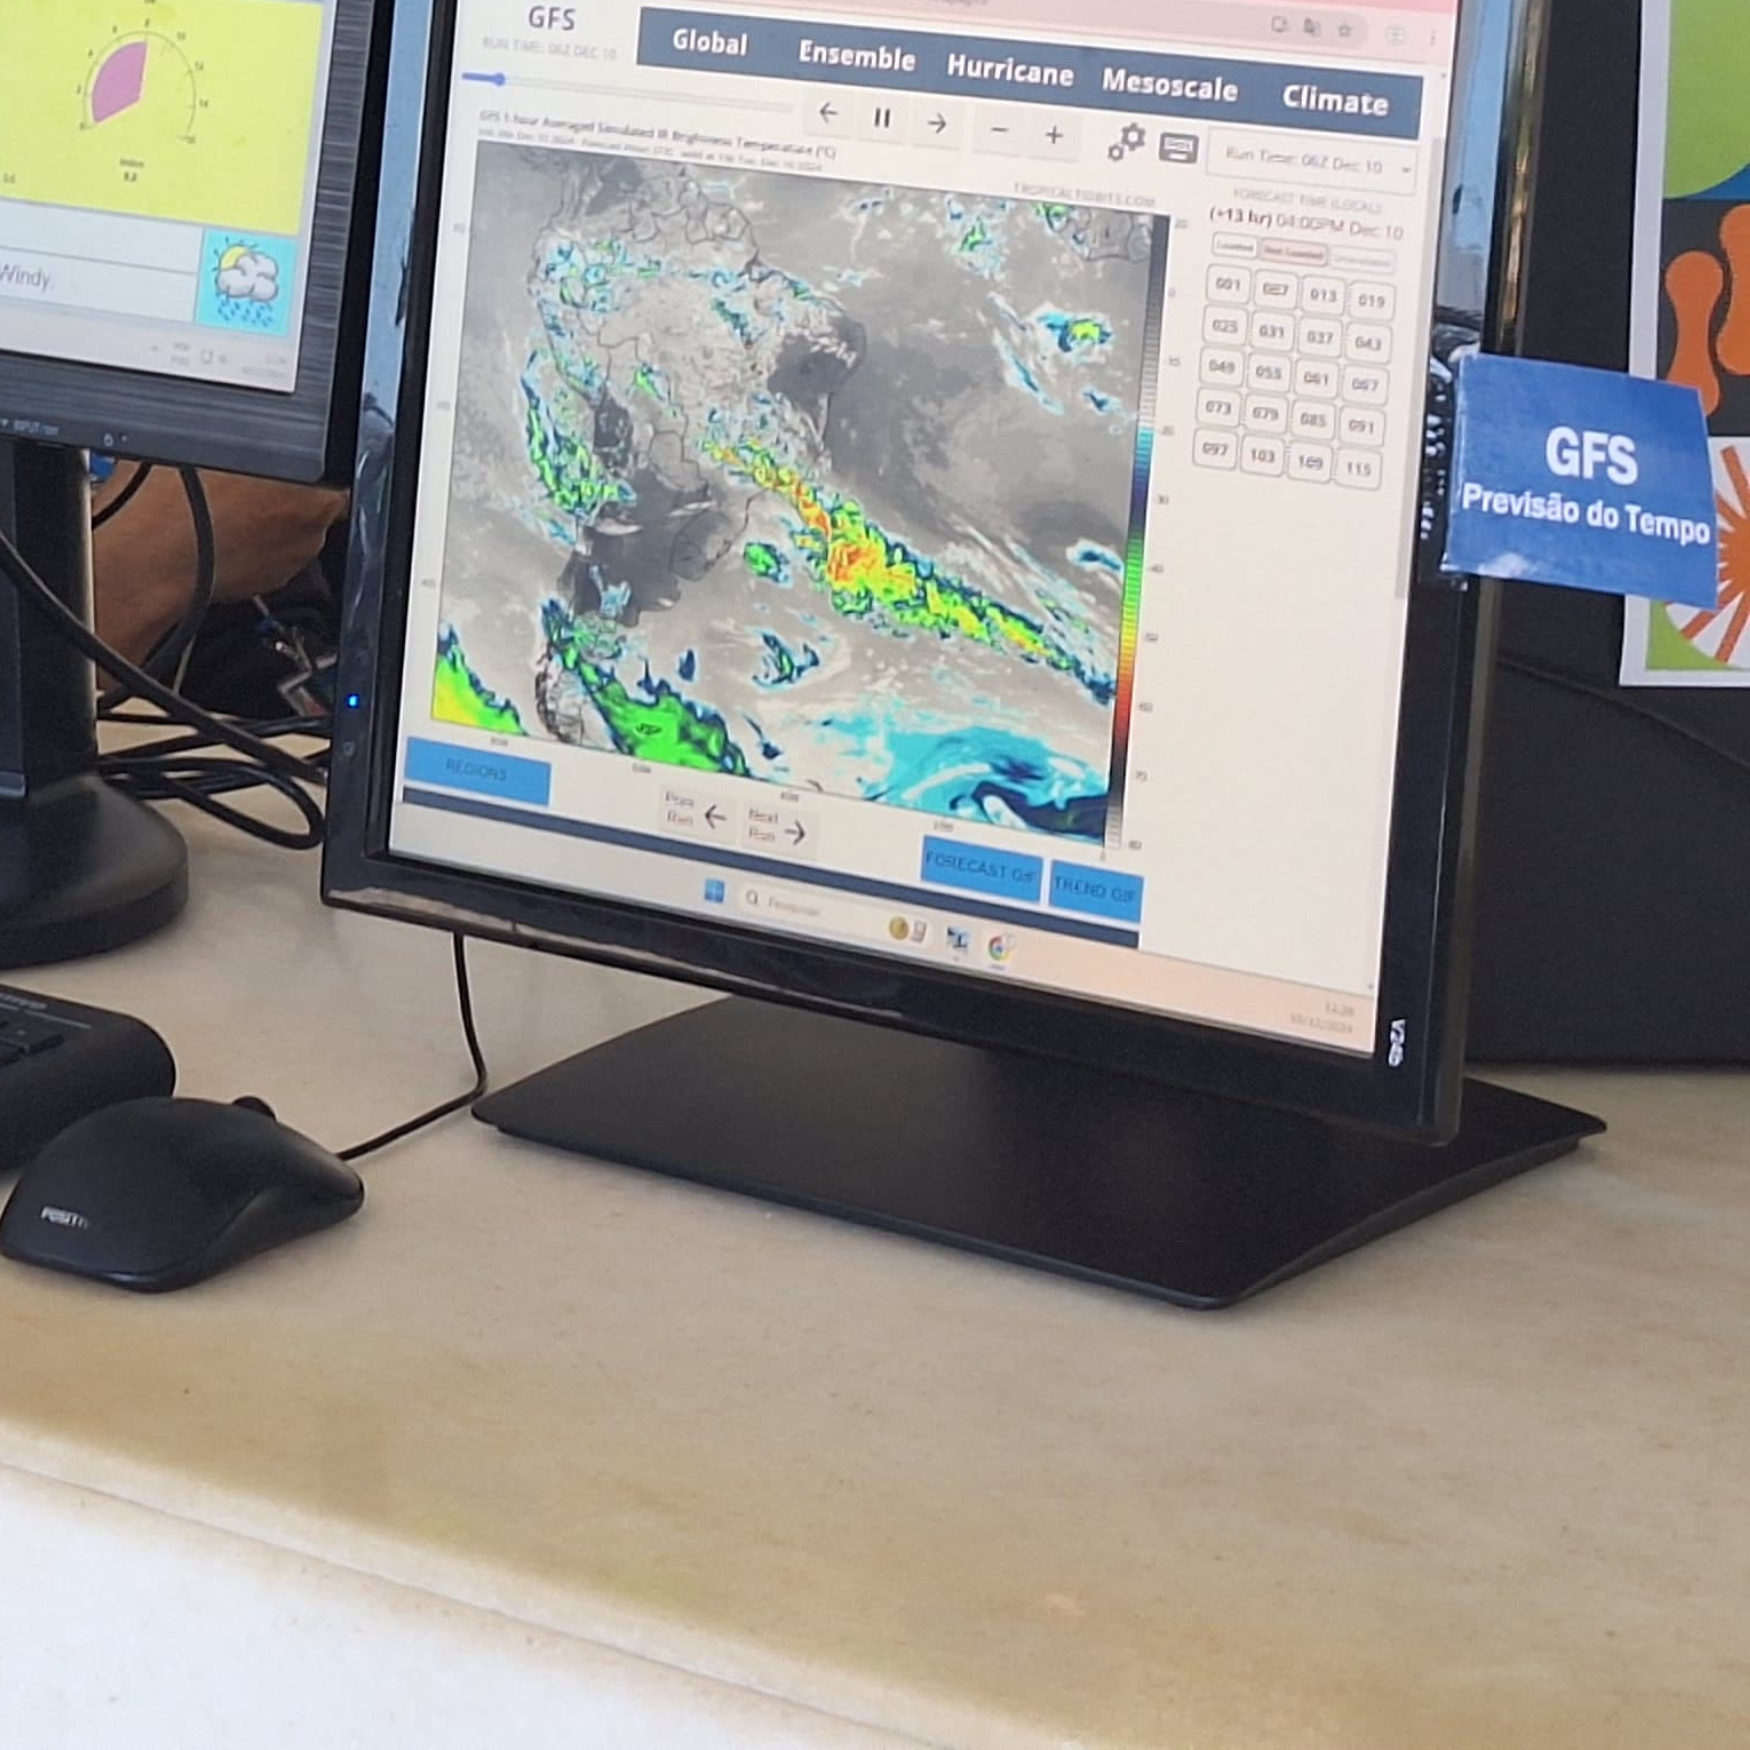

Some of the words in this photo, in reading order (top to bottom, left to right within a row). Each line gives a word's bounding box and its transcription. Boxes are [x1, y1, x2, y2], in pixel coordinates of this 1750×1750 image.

[528, 5, 576, 31] GFS
[673, 28, 748, 56] Global
[799, 40, 916, 72] Ensemble
[948, 53, 1075, 87] Hurricane
[1102, 67, 1239, 102] Mesoscale
[1283, 84, 1390, 116] Climate
[543, 117, 595, 134] Averaged
[599, 122, 654, 138] Simulated
[1226, 146, 1254, 161] Run
[1366, 160, 1383, 174] 10
[1349, 222, 1378, 237] Dec
[1386, 225, 1404, 241] 10
[1546, 426, 1638, 485] GFS
[1462, 482, 1579, 524] Previsão
[1586, 500, 1619, 529] do
[1625, 504, 1711, 547] Tempo
[446, 756, 508, 782] REGIONS
[926, 851, 1006, 878] FORECAST
[1012, 867, 1035, 882] GIF
[1055, 877, 1106, 898] TREND
[1111, 887, 1136, 903] GIF
